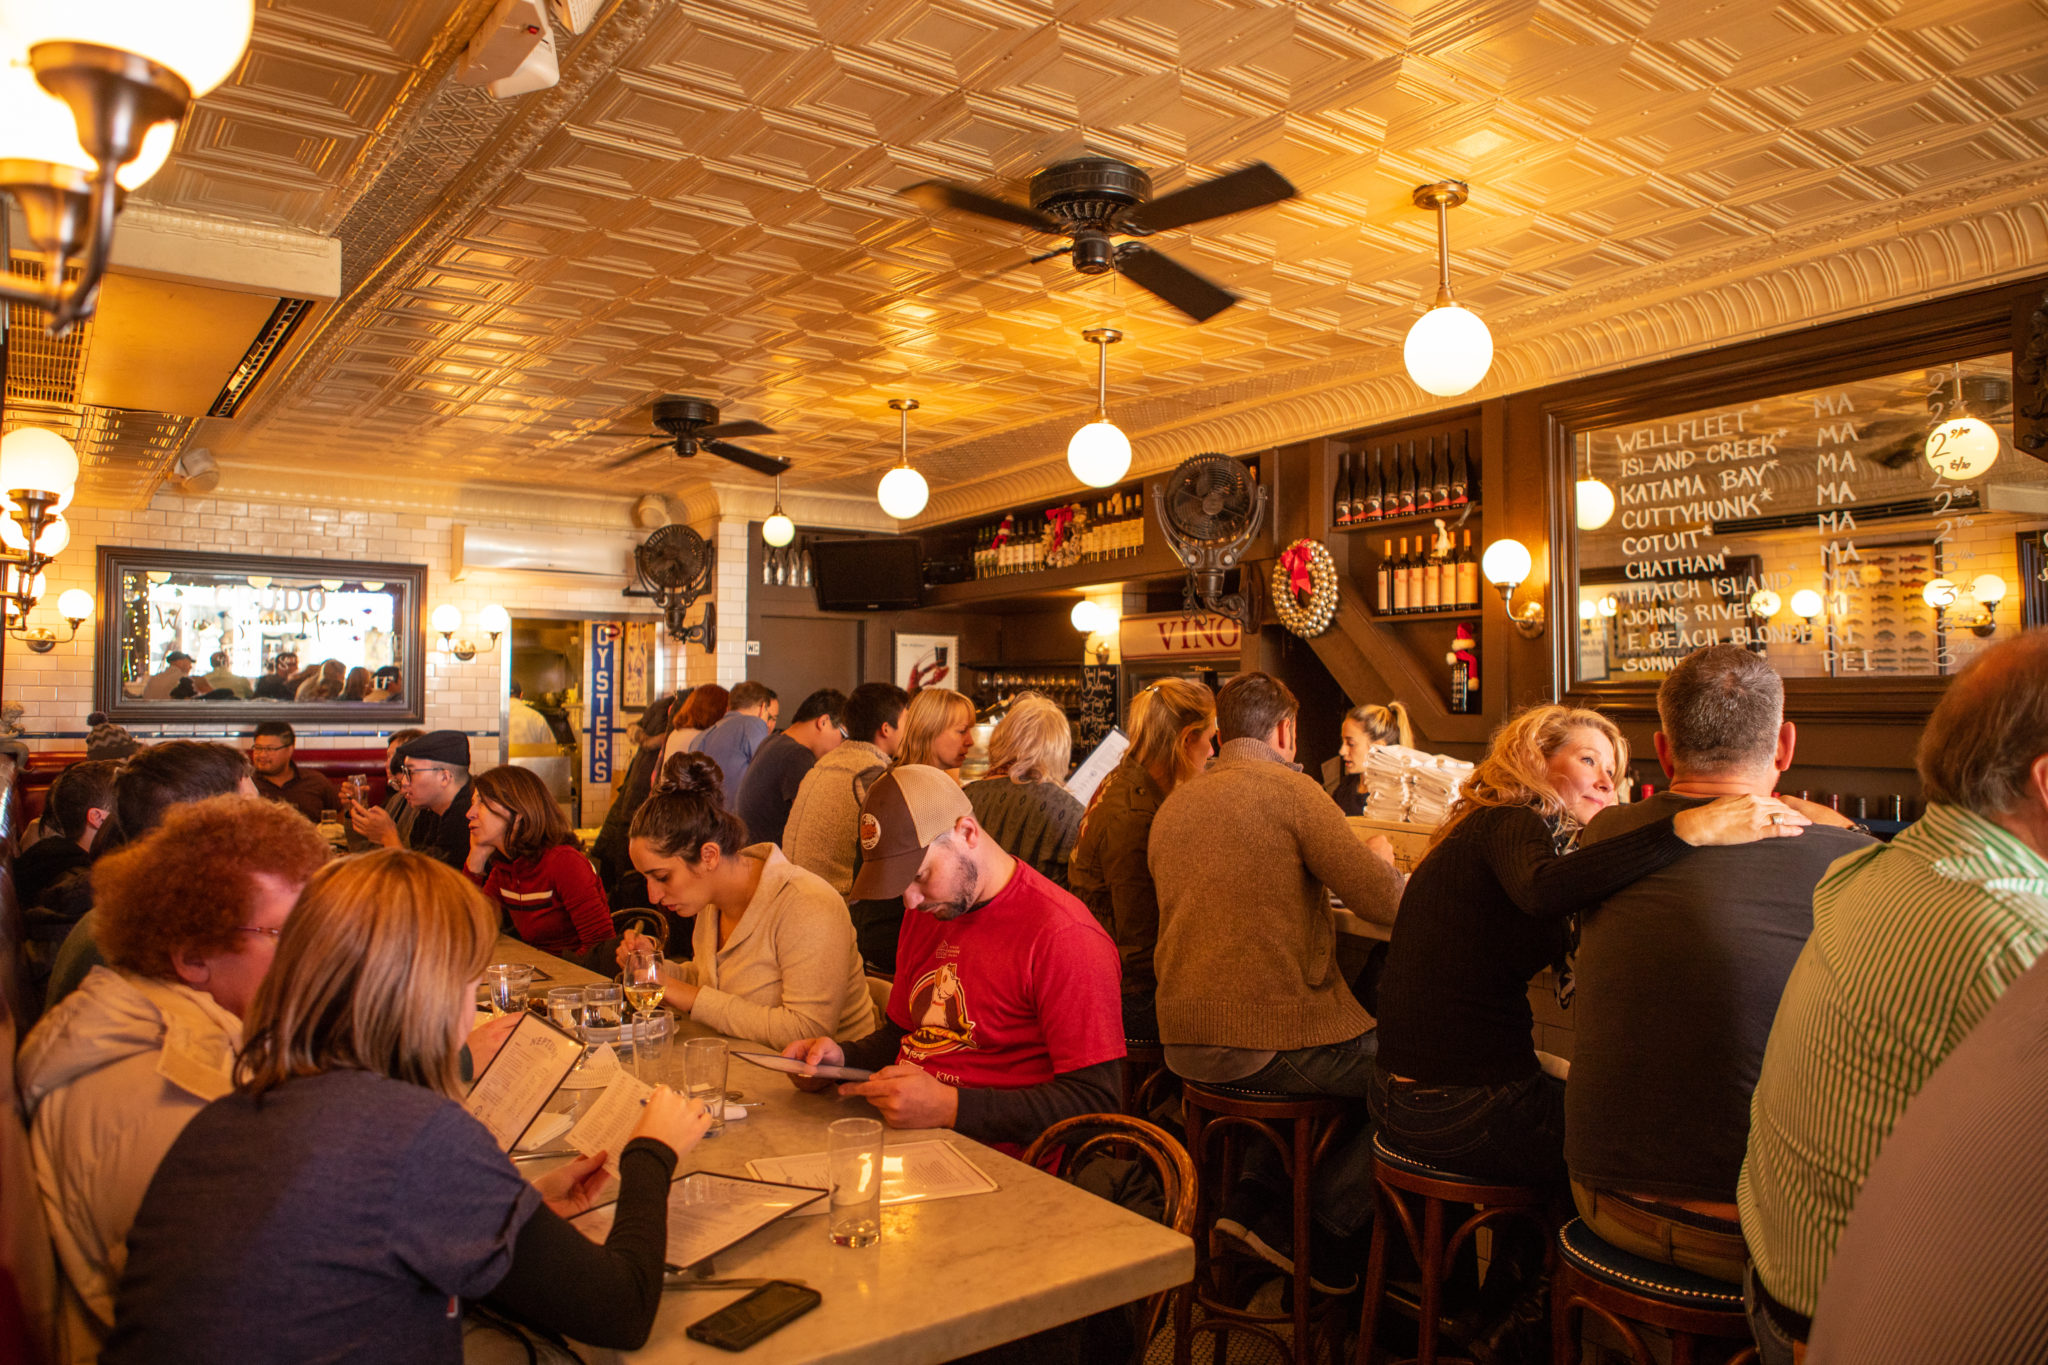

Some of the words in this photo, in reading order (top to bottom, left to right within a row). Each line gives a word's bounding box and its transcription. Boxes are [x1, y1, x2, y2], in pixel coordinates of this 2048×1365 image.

[1814, 392, 1855, 419] MA
[1926, 373, 1945, 397] 2
[1621, 450, 1696, 478] ISLAND
[1817, 422, 1859, 447] MA
[1927, 402, 1946, 425] 2
[1620, 474, 1706, 506] KATAMA
[1817, 450, 1857, 475] MA
[1931, 433, 1950, 458] 2
[1817, 481, 1857, 505] MA
[1931, 465, 1950, 489] 2
[1818, 511, 1856, 535] MA
[1933, 491, 1958, 516] 2
[1820, 541, 1860, 566] MA
[1934, 520, 1953, 544] 2
[1624, 607, 1688, 626] JOHNS
[1823, 594, 1862, 616] ME
[1932, 584, 1958, 607] 3
[1627, 579, 1701, 604] THATCH
[1820, 568, 1861, 590] MA
[747, 643, 758, 653] WC
[1157, 615, 1239, 650] VINO
[1649, 628, 1719, 649] BEACH
[1823, 624, 1856, 645] RI
[1820, 650, 1875, 672] PEI
[594, 625, 610, 782] OYSTERS
